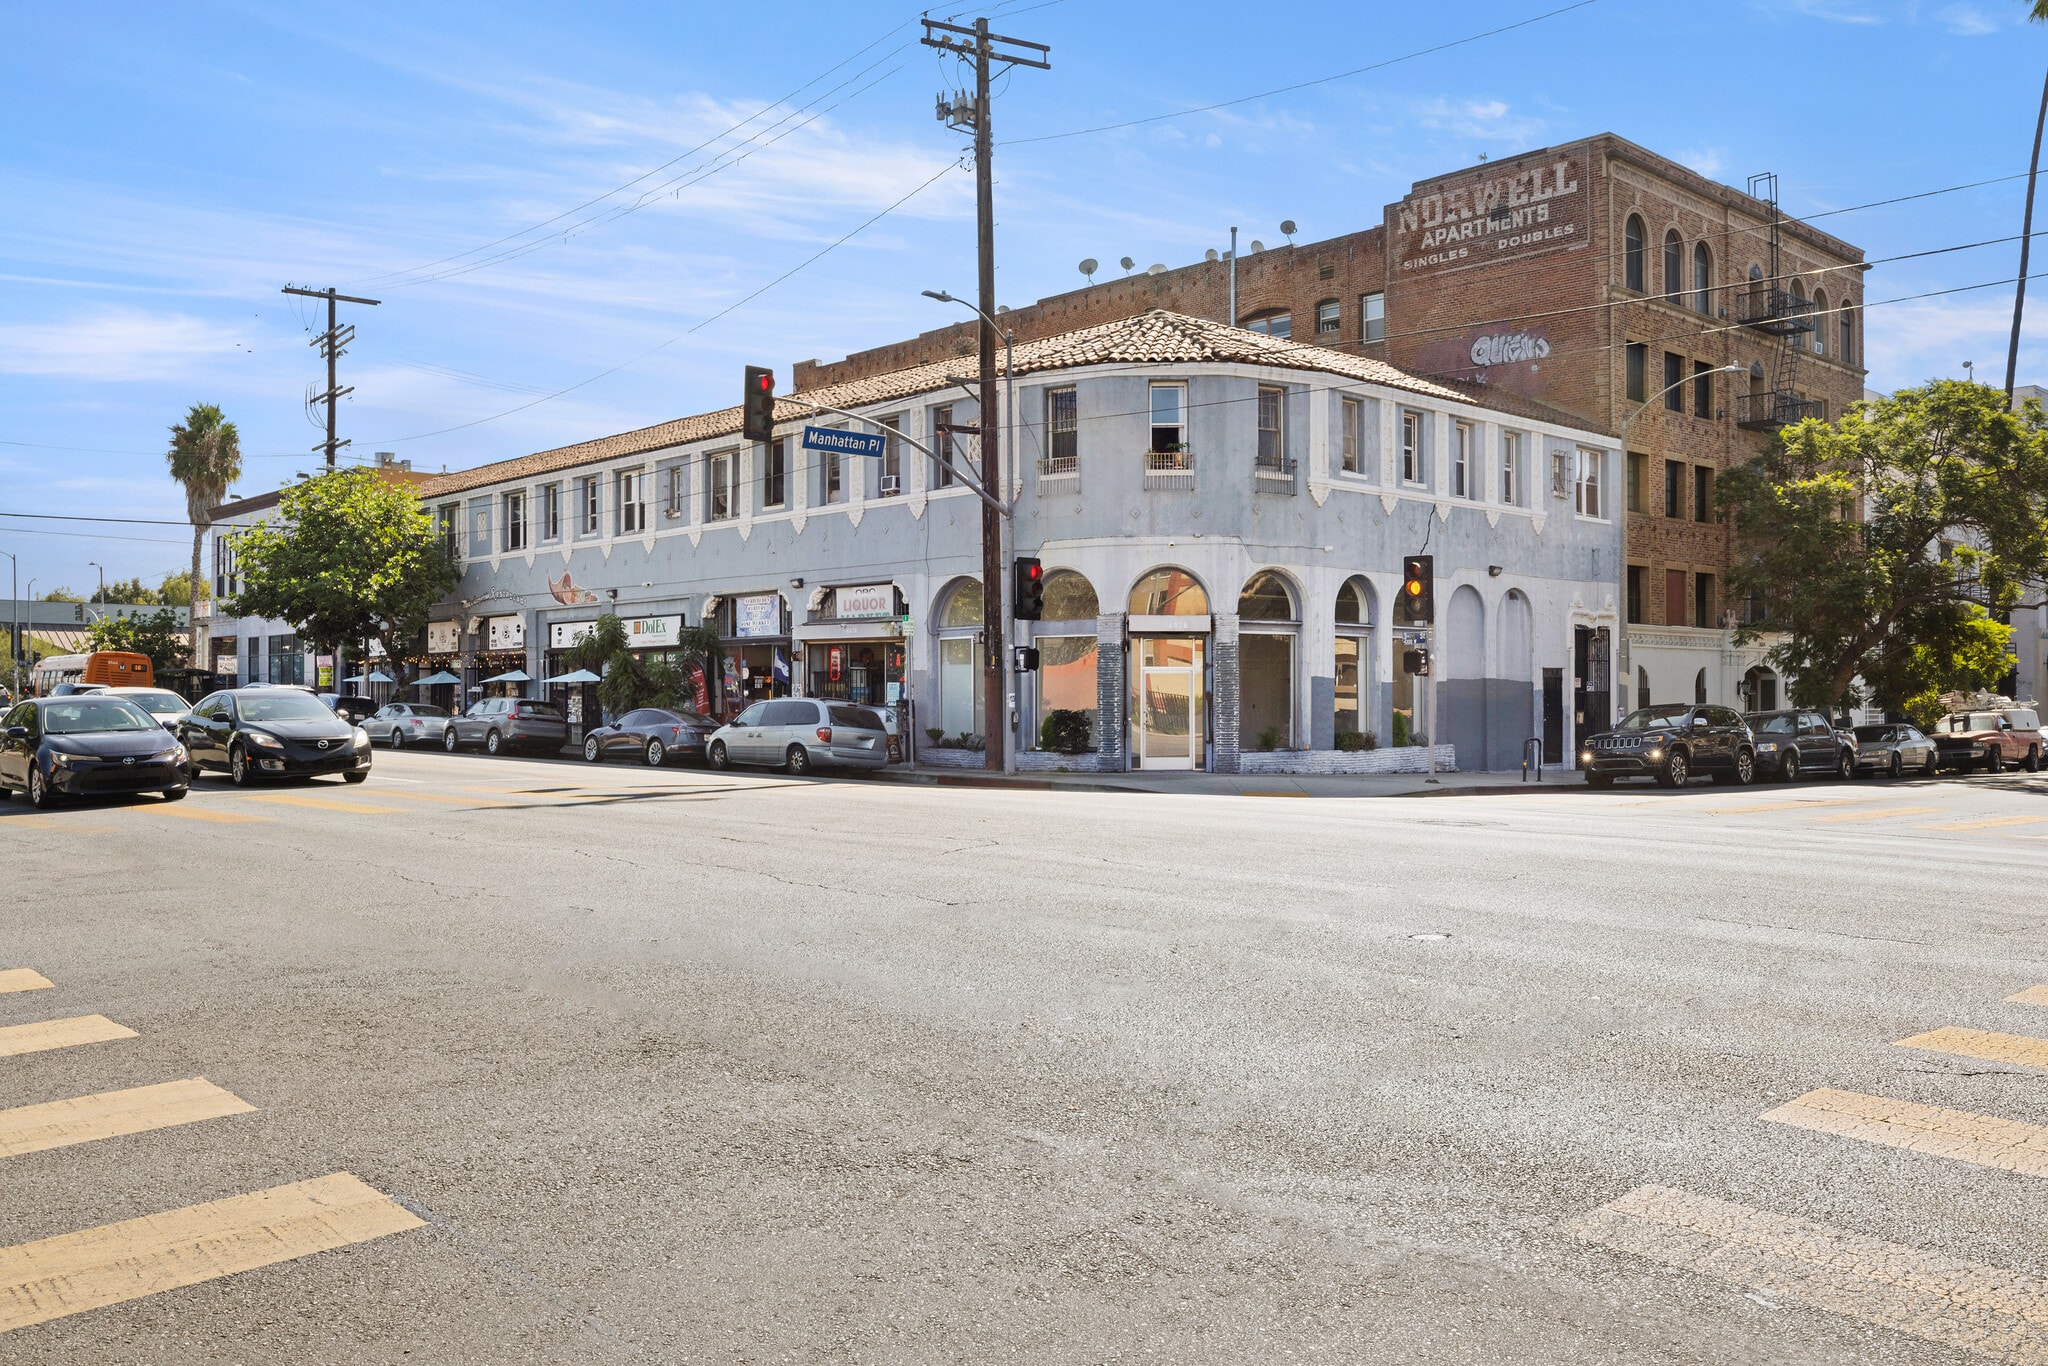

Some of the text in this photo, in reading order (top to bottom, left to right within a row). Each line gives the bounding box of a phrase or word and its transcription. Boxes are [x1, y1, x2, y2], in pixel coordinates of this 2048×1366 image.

[1421, 203, 1549, 249] APARTMENTS
[1403, 223, 1575, 270] SINGLES DOUBLES
[808, 430, 880, 452] Manhattan Pl
[843, 597, 886, 612] LIQUOR
[840, 611, 890, 619] RKET
[641, 619, 667, 634] DolEx
